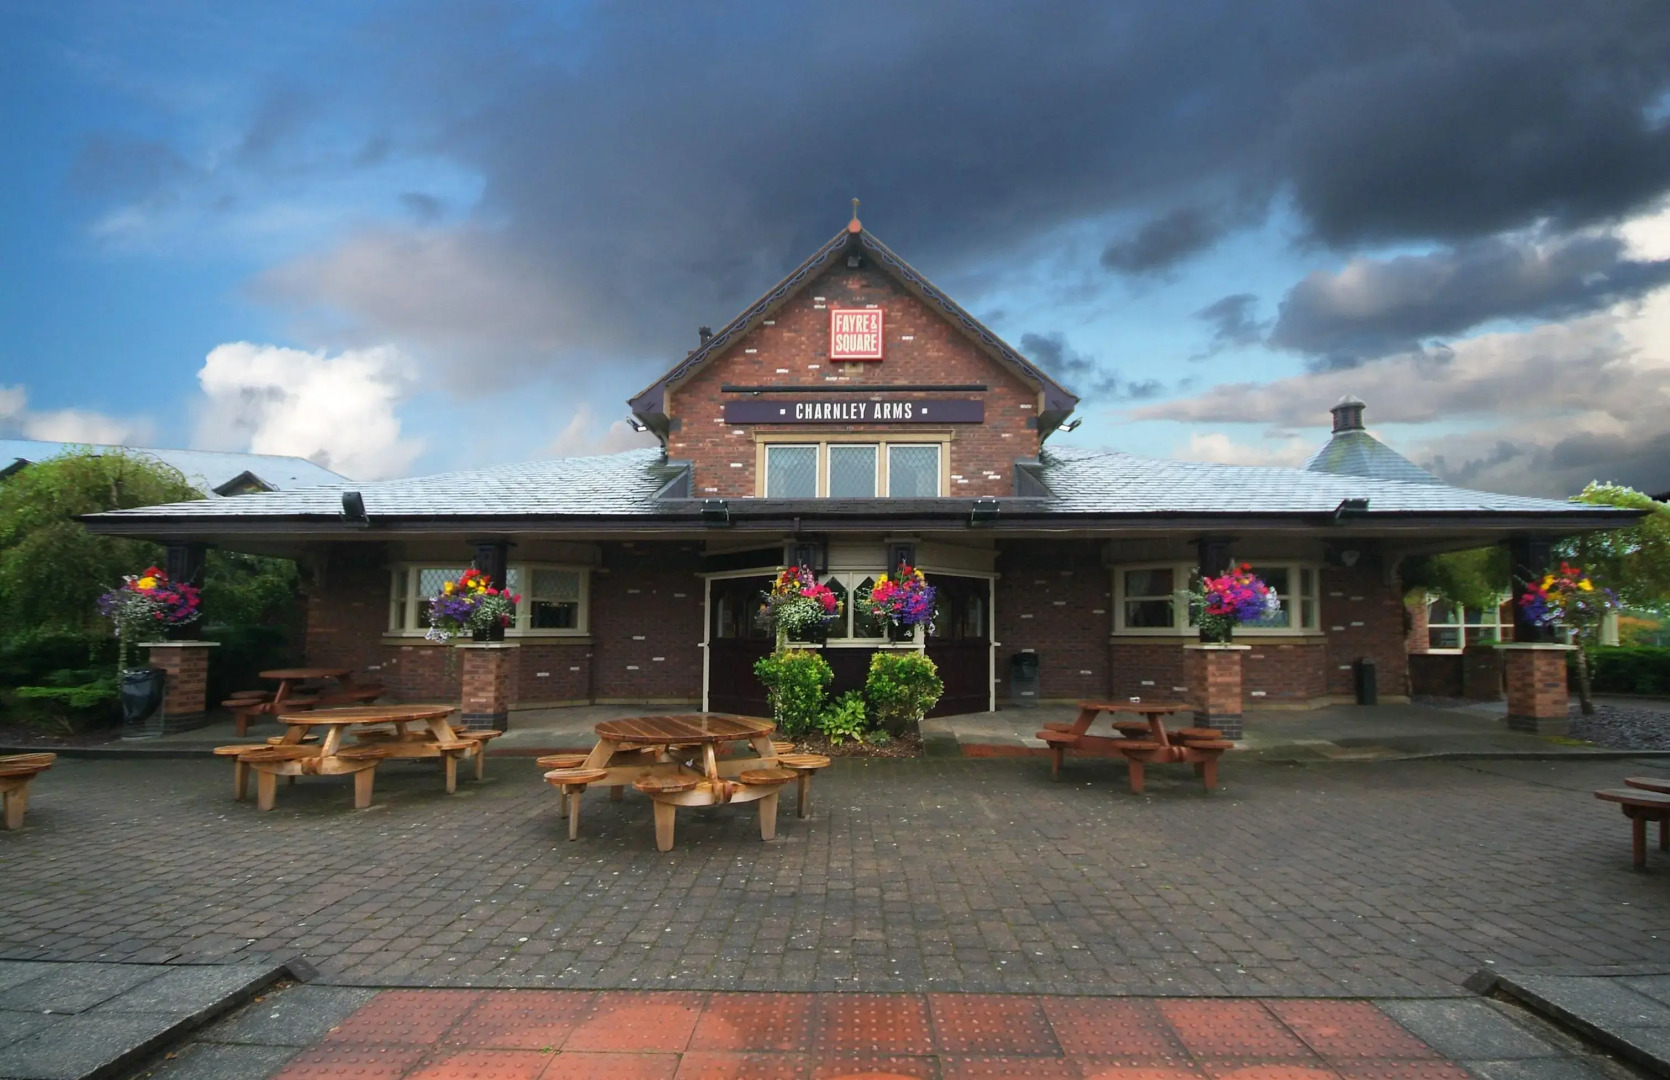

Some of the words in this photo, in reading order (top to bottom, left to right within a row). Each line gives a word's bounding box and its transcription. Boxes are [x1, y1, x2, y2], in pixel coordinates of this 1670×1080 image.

[836, 314, 869, 332] FAYRE
[870, 314, 877, 332] &
[835, 334, 877, 353] SQUARE
[795, 403, 867, 419] CHARNLEY
[873, 402, 912, 419] ARMS
